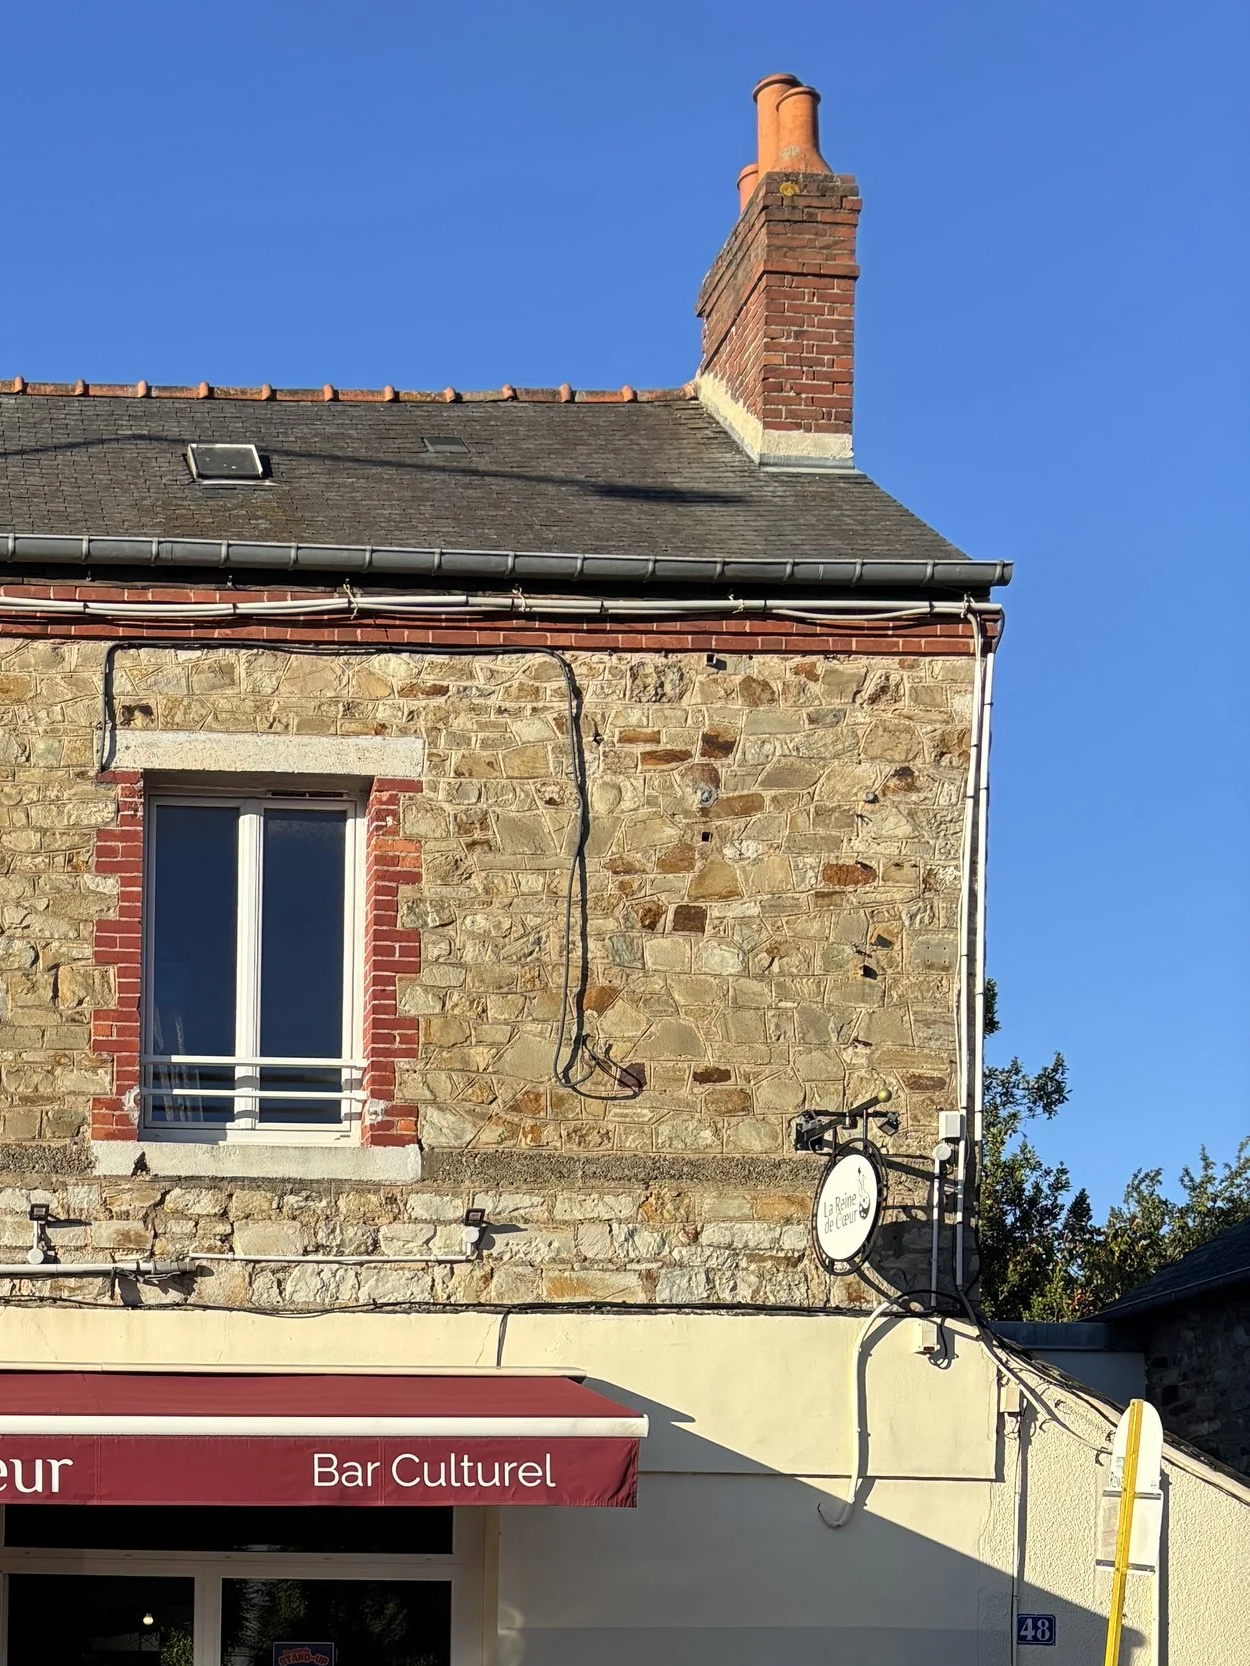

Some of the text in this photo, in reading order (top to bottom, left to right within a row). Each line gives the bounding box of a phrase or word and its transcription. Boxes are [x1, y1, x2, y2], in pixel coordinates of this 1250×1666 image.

[823, 1193, 857, 1218] La Reine
[824, 1217, 834, 1234] de
[312, 1453, 556, 1488] Bar Culturel
[1019, 1617, 1051, 1641] 48
